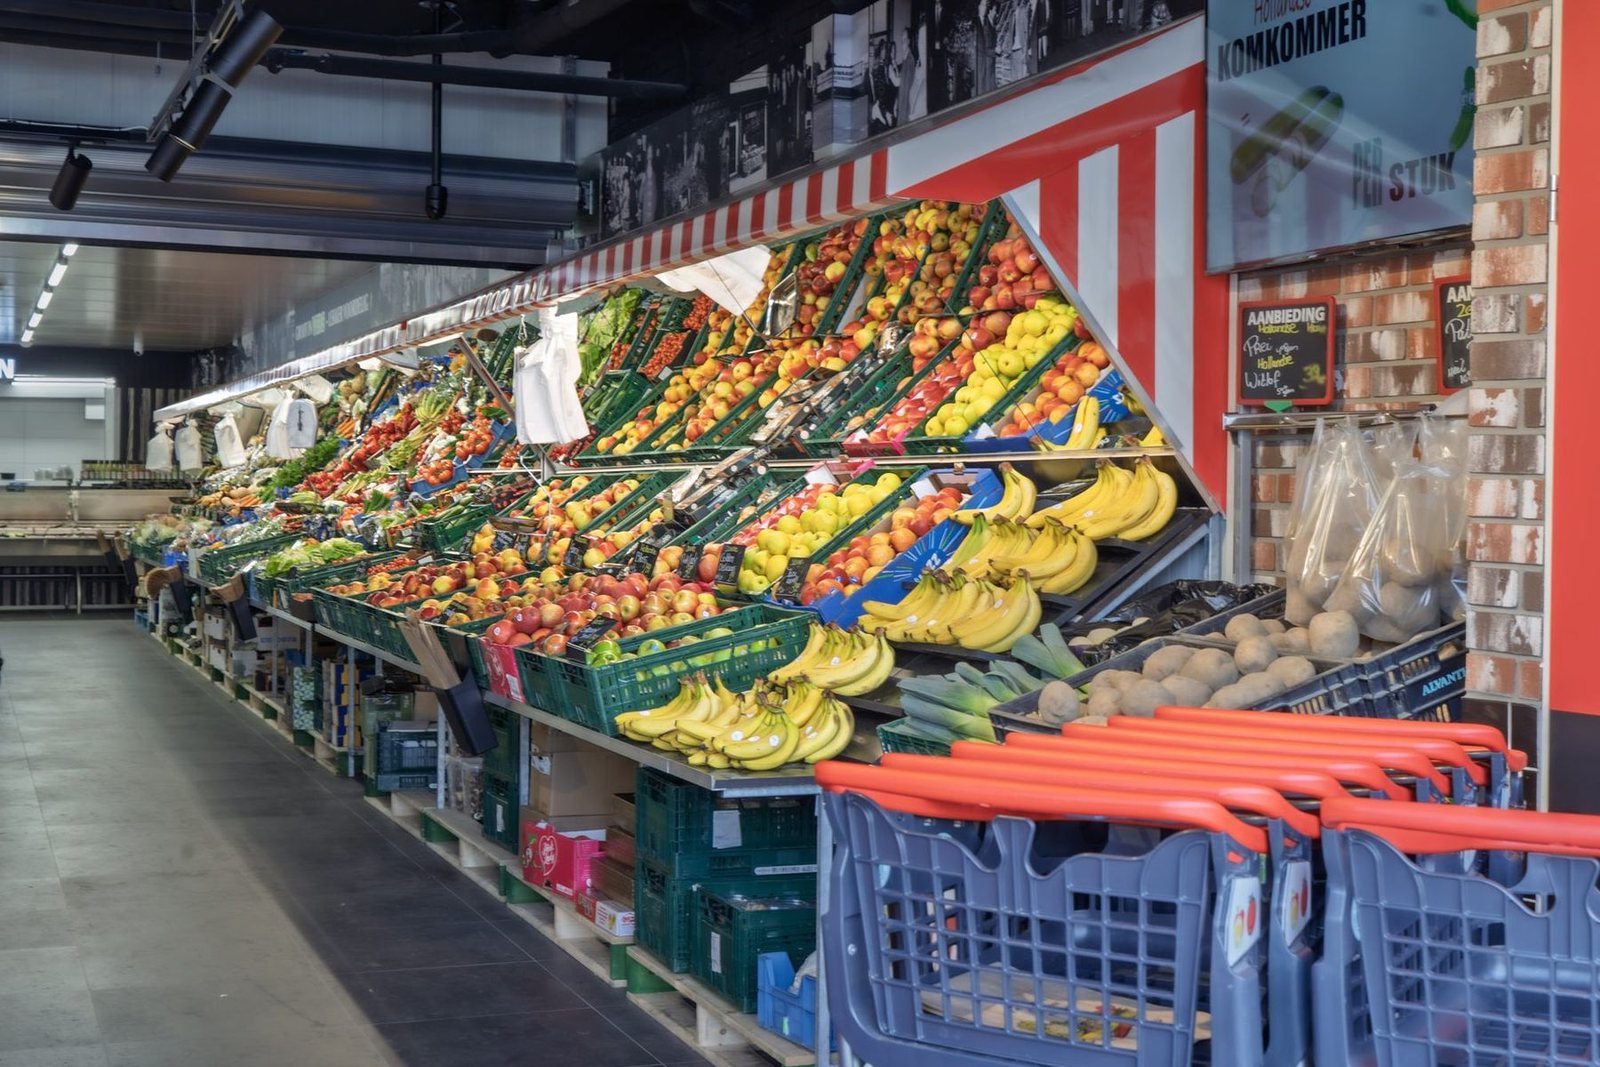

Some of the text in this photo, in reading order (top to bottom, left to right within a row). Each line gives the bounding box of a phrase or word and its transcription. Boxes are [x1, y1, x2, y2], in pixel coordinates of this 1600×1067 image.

[1218, 0, 1367, 82] KOMKOMMER
[1389, 151, 1456, 202] STUK
[1247, 306, 1326, 326] AANBIEDING
